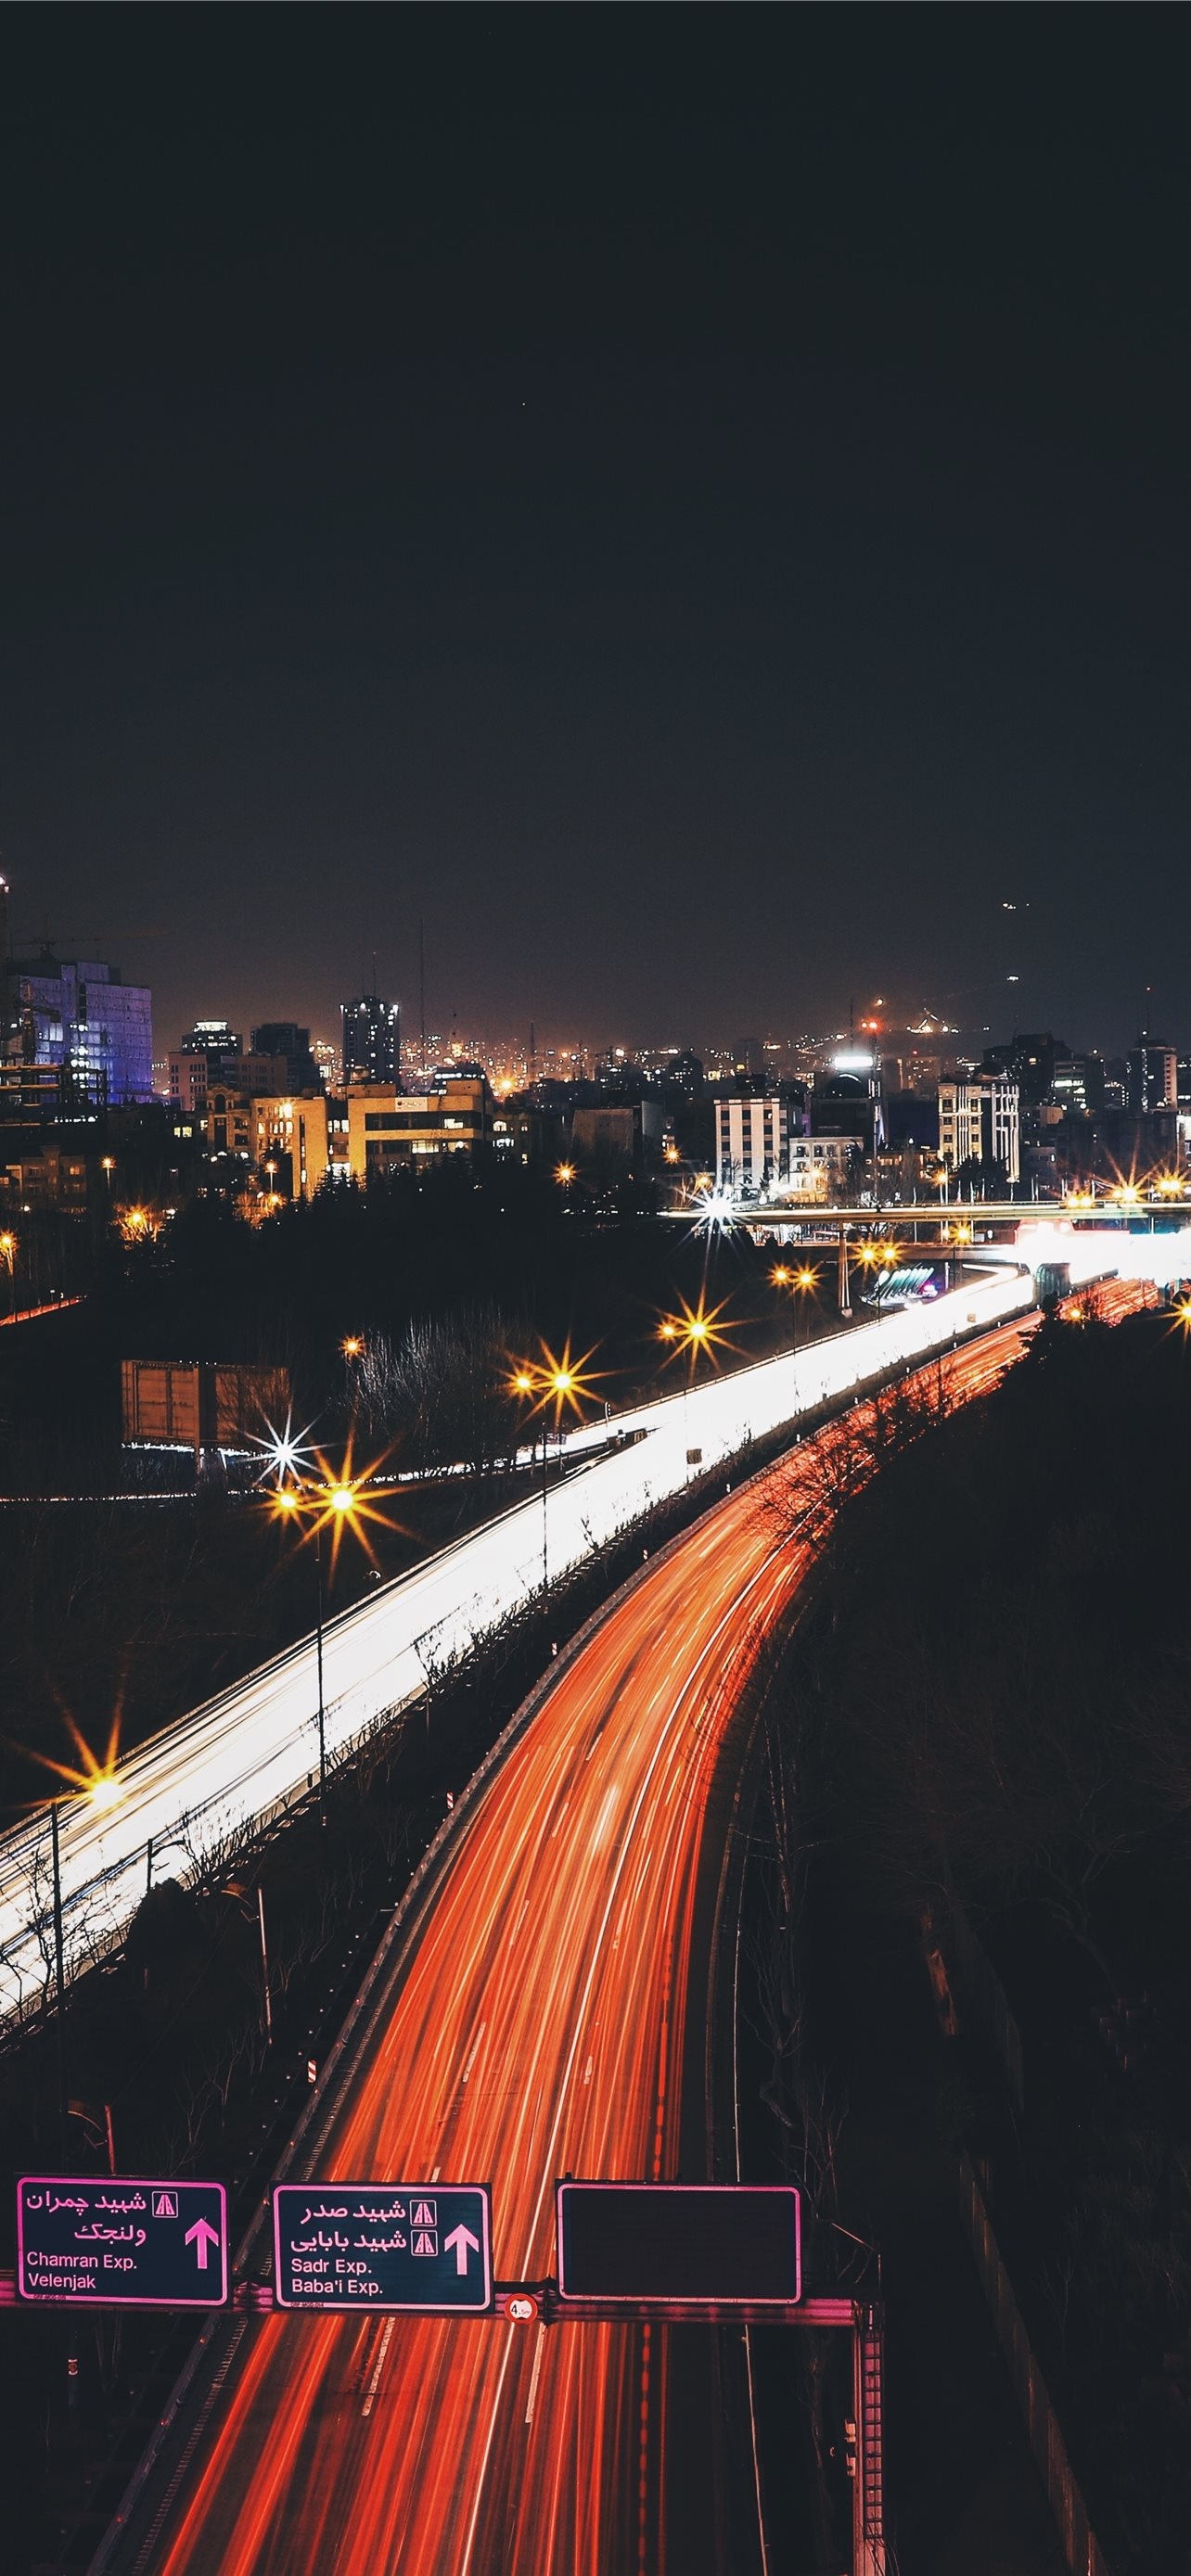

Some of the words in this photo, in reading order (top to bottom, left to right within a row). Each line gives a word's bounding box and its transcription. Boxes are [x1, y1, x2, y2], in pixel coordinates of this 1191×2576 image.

[26, 2190, 90, 2216] چمران
[95, 2192, 147, 2214] شهید
[352, 2200, 406, 2223] شهید
[300, 2204, 349, 2225] صدر
[352, 2230, 407, 2252] شهید
[26, 2251, 98, 2268] Chamran
[103, 2254, 137, 2272] Exp.
[290, 2257, 330, 2274] Sadr
[335, 2259, 372, 2276] Exp.
[28, 2272, 96, 2291] Velenjak
[291, 2278, 343, 2294] Baba'i
[347, 2278, 383, 2297] Exp.
